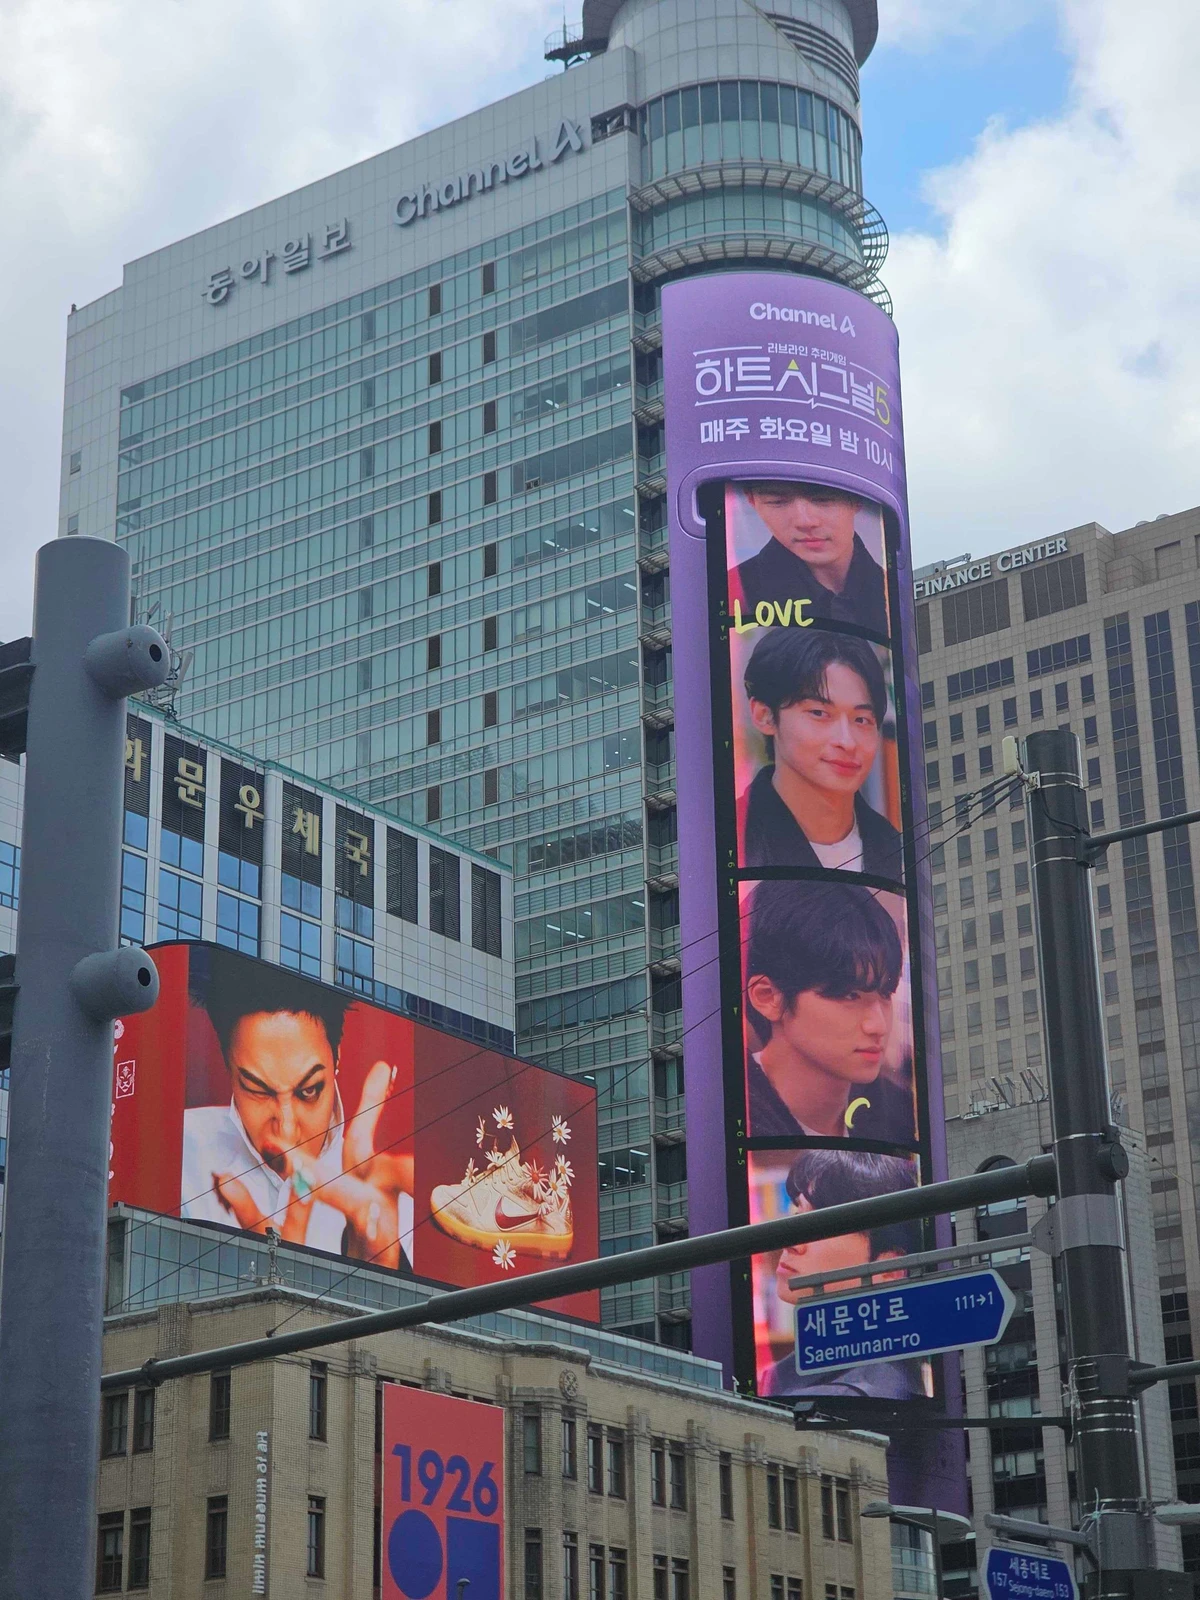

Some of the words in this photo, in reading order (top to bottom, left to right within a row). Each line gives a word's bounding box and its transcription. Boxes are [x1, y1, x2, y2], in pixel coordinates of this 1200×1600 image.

[393, 135, 542, 227] Channel
[547, 115, 583, 164] A
[201, 217, 352, 306] 동아일보
[749, 302, 837, 331] Channel
[840, 315, 856, 337] A
[767, 342, 808, 357] 러브라인
[811, 347, 847, 366] 추리게임
[700, 417, 750, 443] 매주
[759, 416, 832, 447] 화요일
[839, 427, 859, 455] 밤
[864, 437, 893, 474] 10시
[913, 561, 991, 600] FINANCE
[997, 537, 1068, 573] CENTER
[804, 1297, 910, 1338] 새문안로
[805, 1333, 921, 1364] Saemunan-ro
[256, 1431, 268, 1453] art
[256, 1456, 267, 1474] of
[391, 1443, 499, 1518] 1926
[255, 1478, 267, 1549] museum
[992, 1571, 1008, 1587] 157
[1054, 1583, 1069, 1598] 153
[1009, 1557, 1051, 1580] 세종대로
